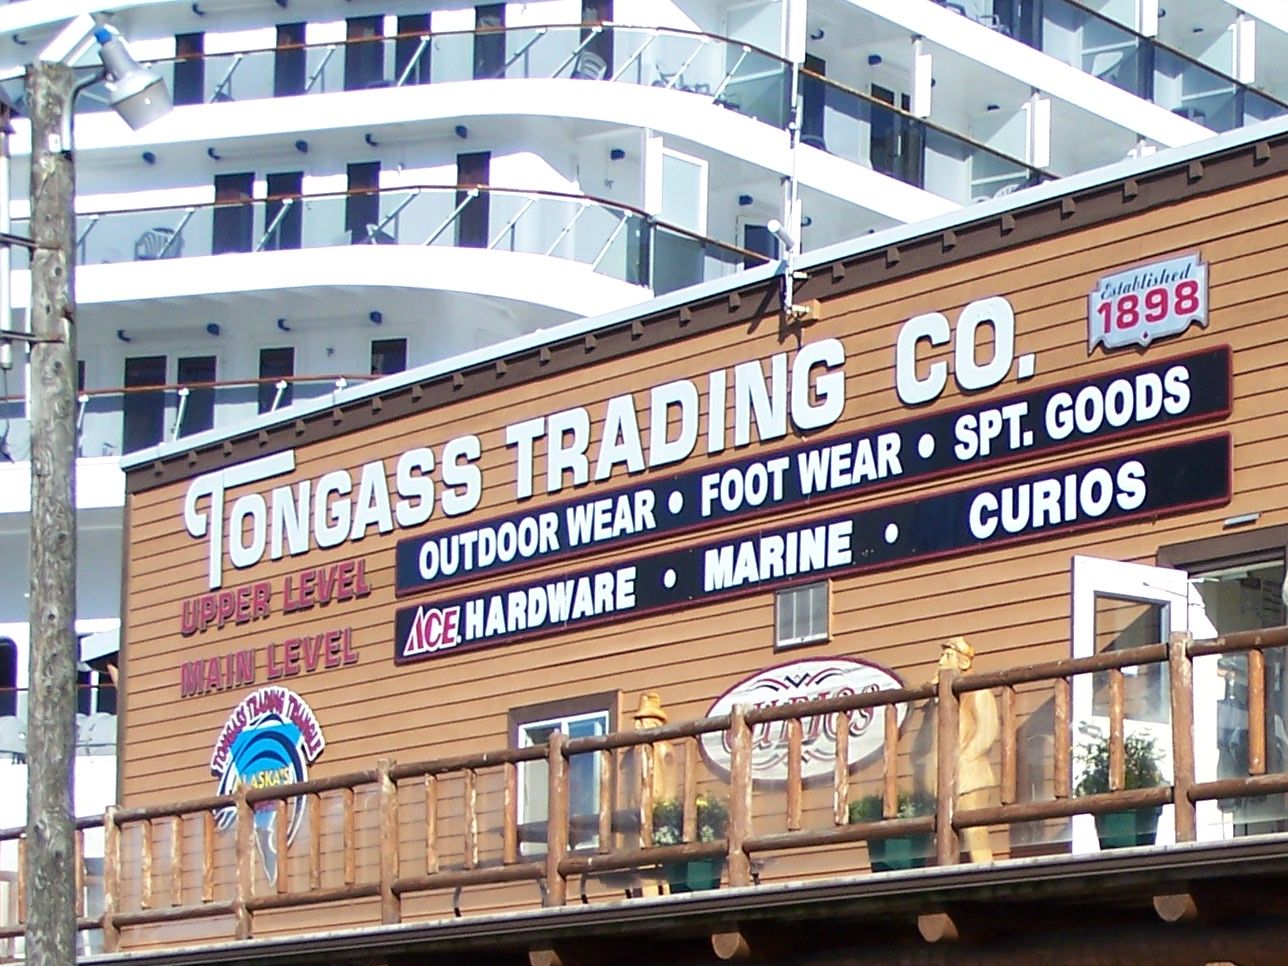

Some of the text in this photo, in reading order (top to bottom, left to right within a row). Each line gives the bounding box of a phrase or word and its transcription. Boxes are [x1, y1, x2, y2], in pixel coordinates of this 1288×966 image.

[1097, 280, 1200, 334] 1898
[1101, 262, 1192, 300] Established
[184, 296, 1036, 589] TONGASS TRADING CO.
[418, 365, 1192, 580] OUTDOOR WEAR FOOT WEAR SPT. GOODS
[403, 461, 1147, 656] ACE HARDWARE MARINE CURIOS
[180, 559, 372, 637] UPPER LEVEL
[180, 627, 359, 697] MAIN LEVEL
